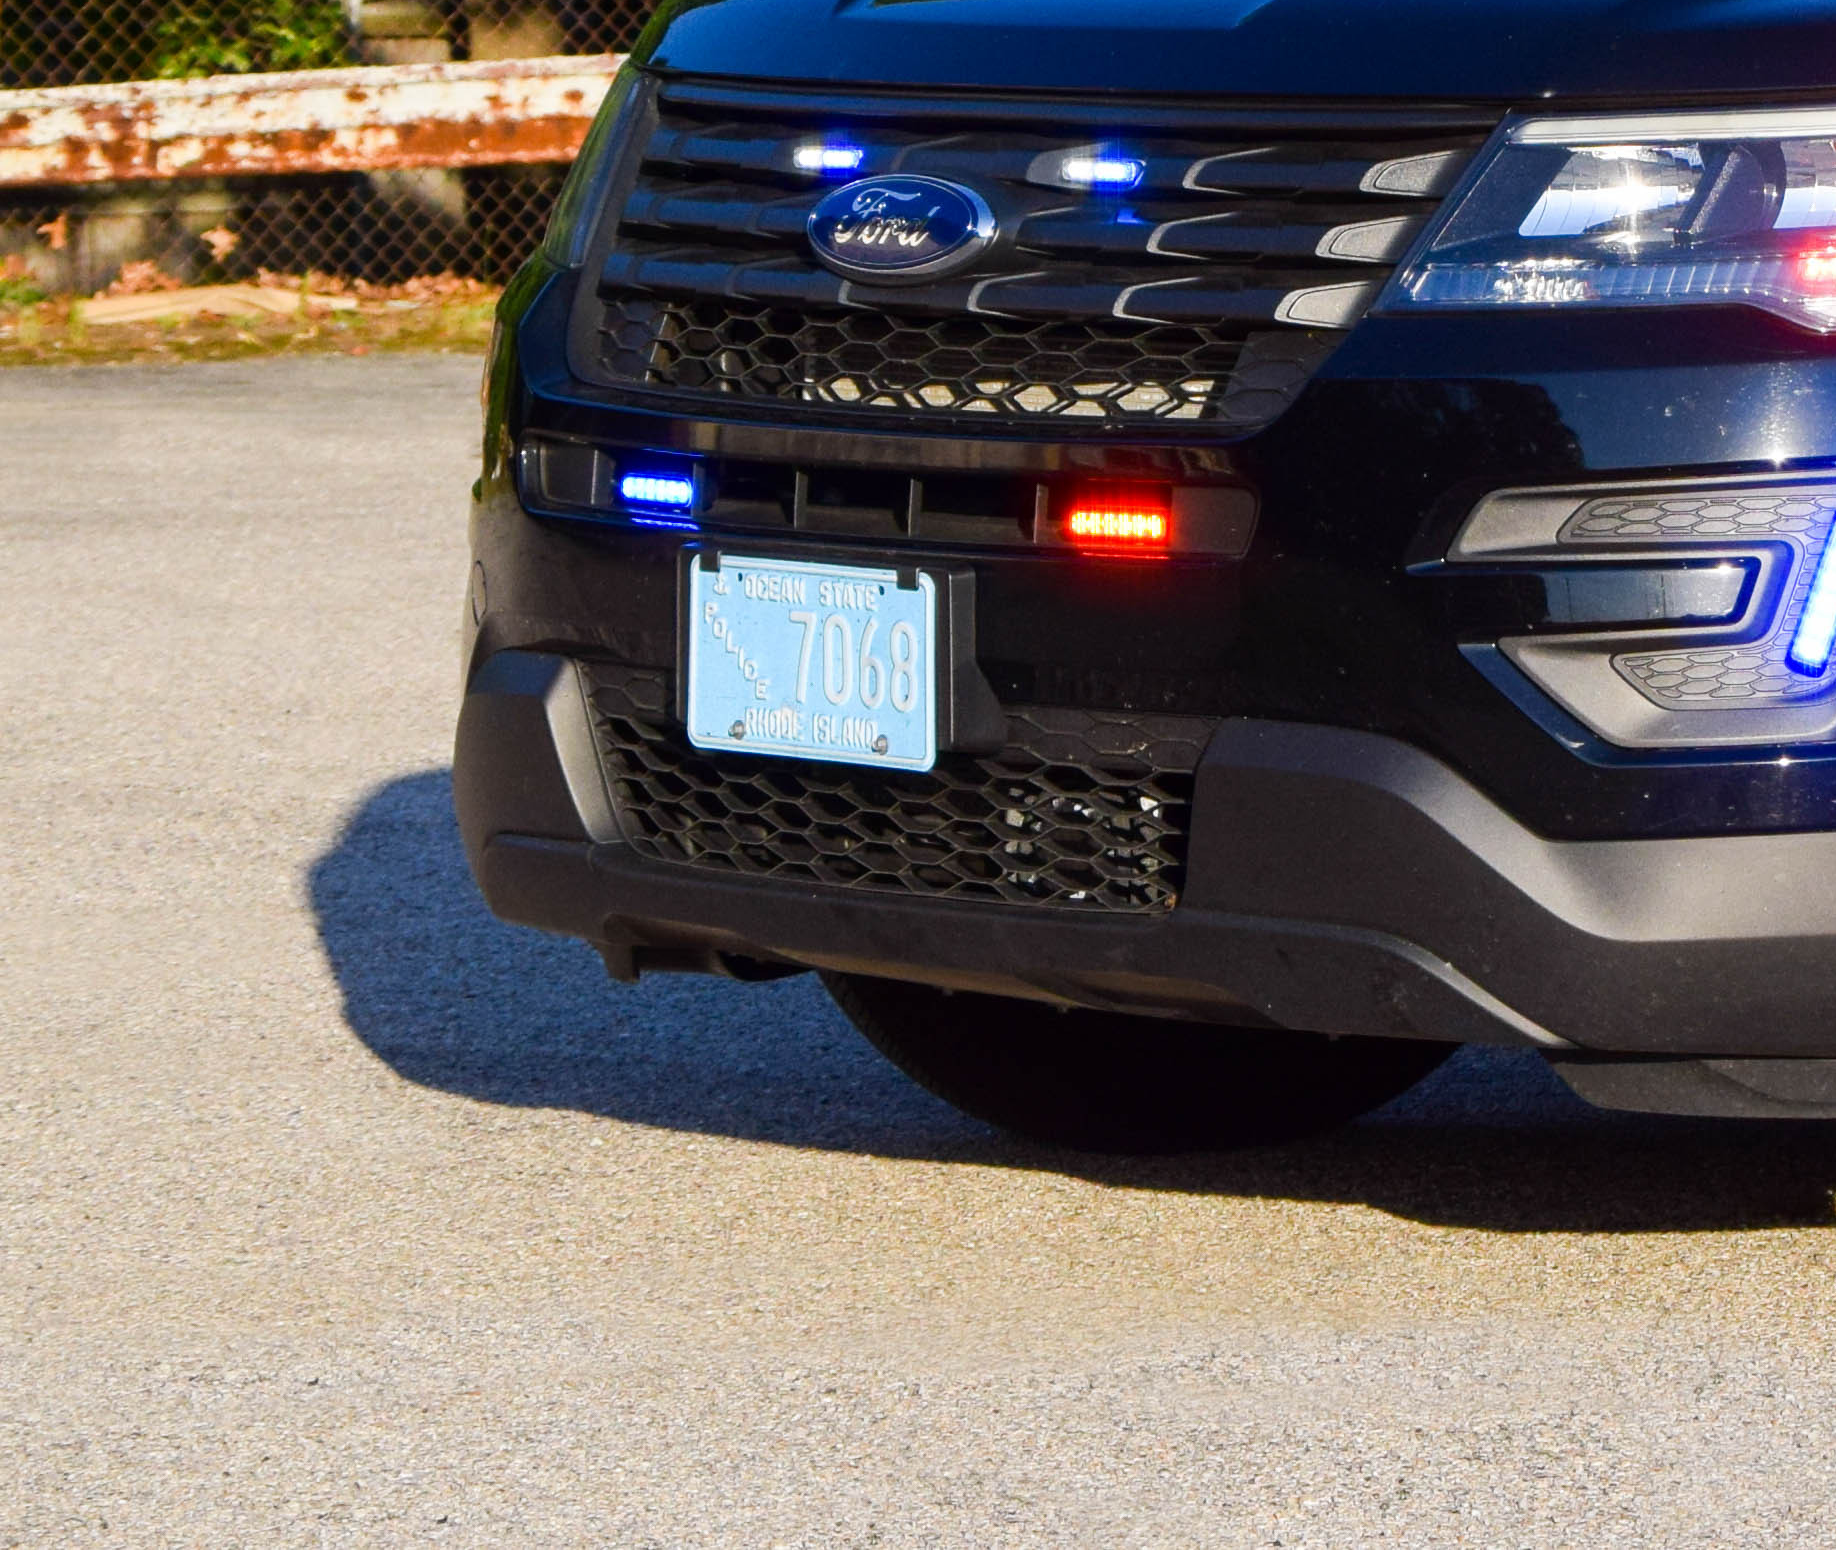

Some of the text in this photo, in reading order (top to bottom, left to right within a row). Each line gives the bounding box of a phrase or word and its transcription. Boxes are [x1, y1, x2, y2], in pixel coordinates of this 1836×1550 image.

[832, 187, 941, 247] Ford
[744, 573, 879, 612] OCEAN STATE
[788, 610, 919, 713] 7068
[744, 706, 879, 749] RHODE ISLAND
